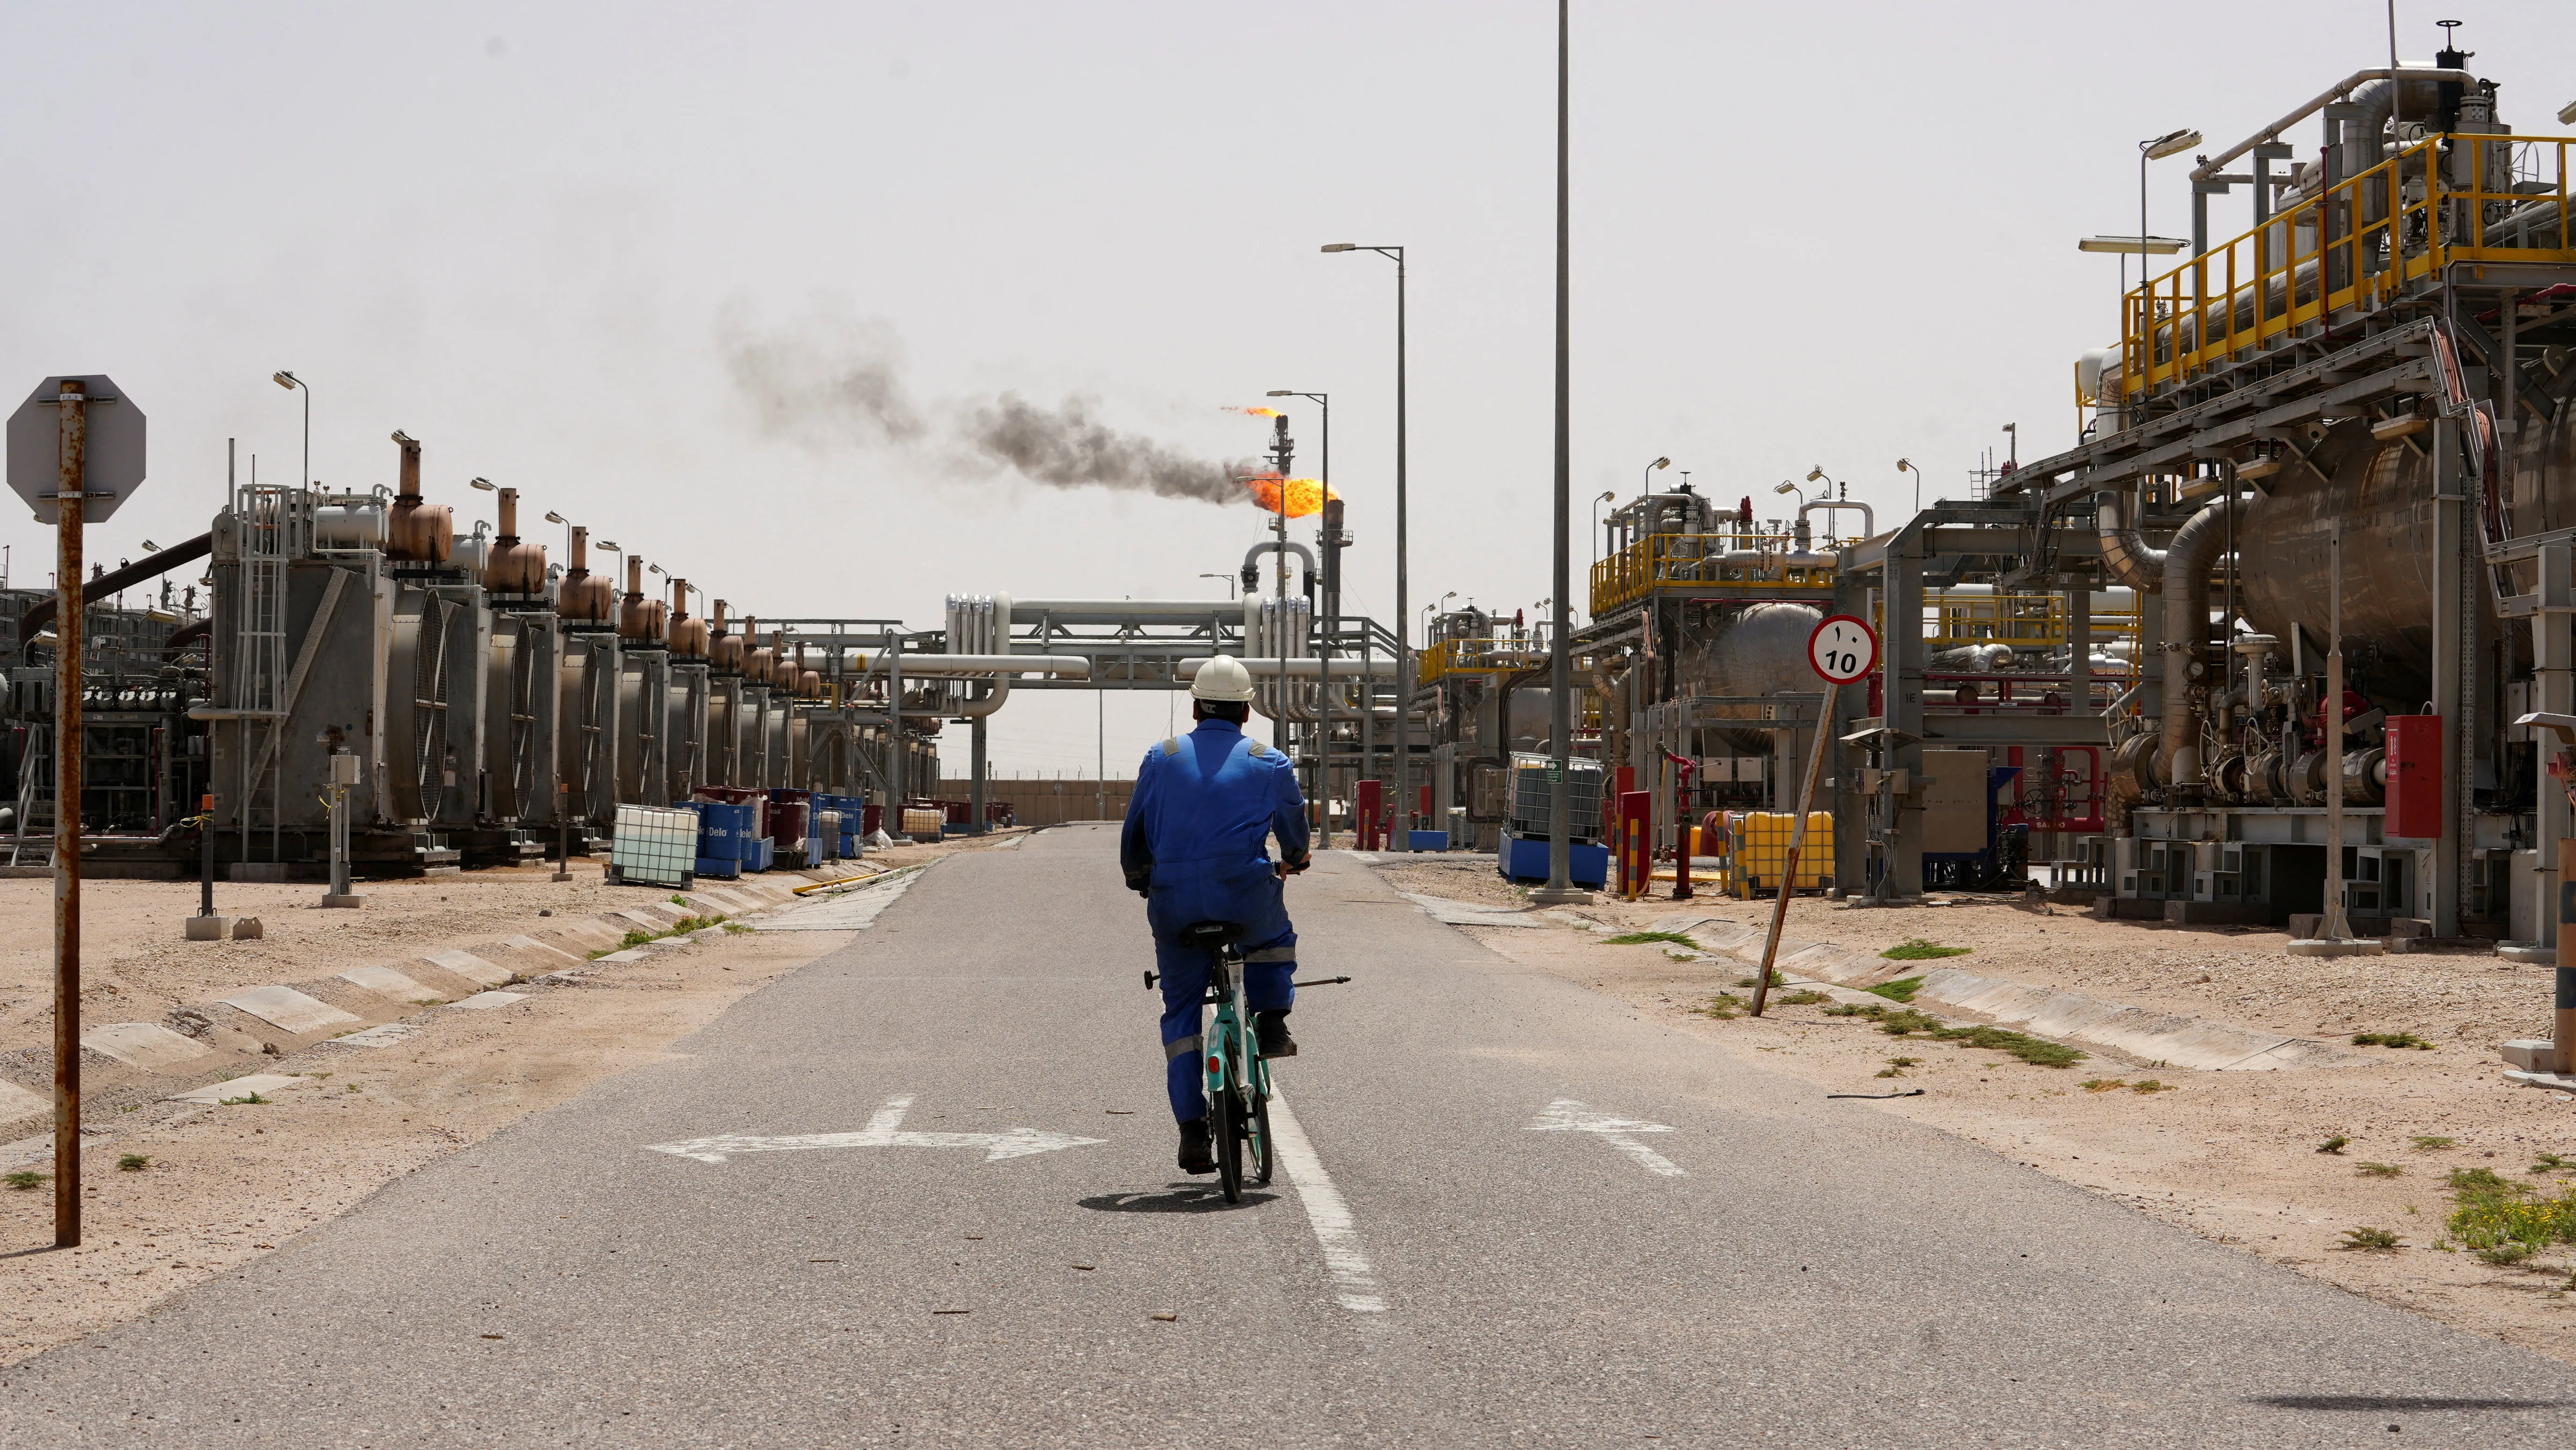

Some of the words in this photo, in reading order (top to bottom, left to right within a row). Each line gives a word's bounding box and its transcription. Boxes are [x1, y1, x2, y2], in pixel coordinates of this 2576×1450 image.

[1835, 626, 1858, 643] ١٠
[1826, 650, 1856, 673] 10
[1905, 693, 1916, 703] 1E
[709, 827, 727, 837] Delo
[740, 829, 751, 838] elo
